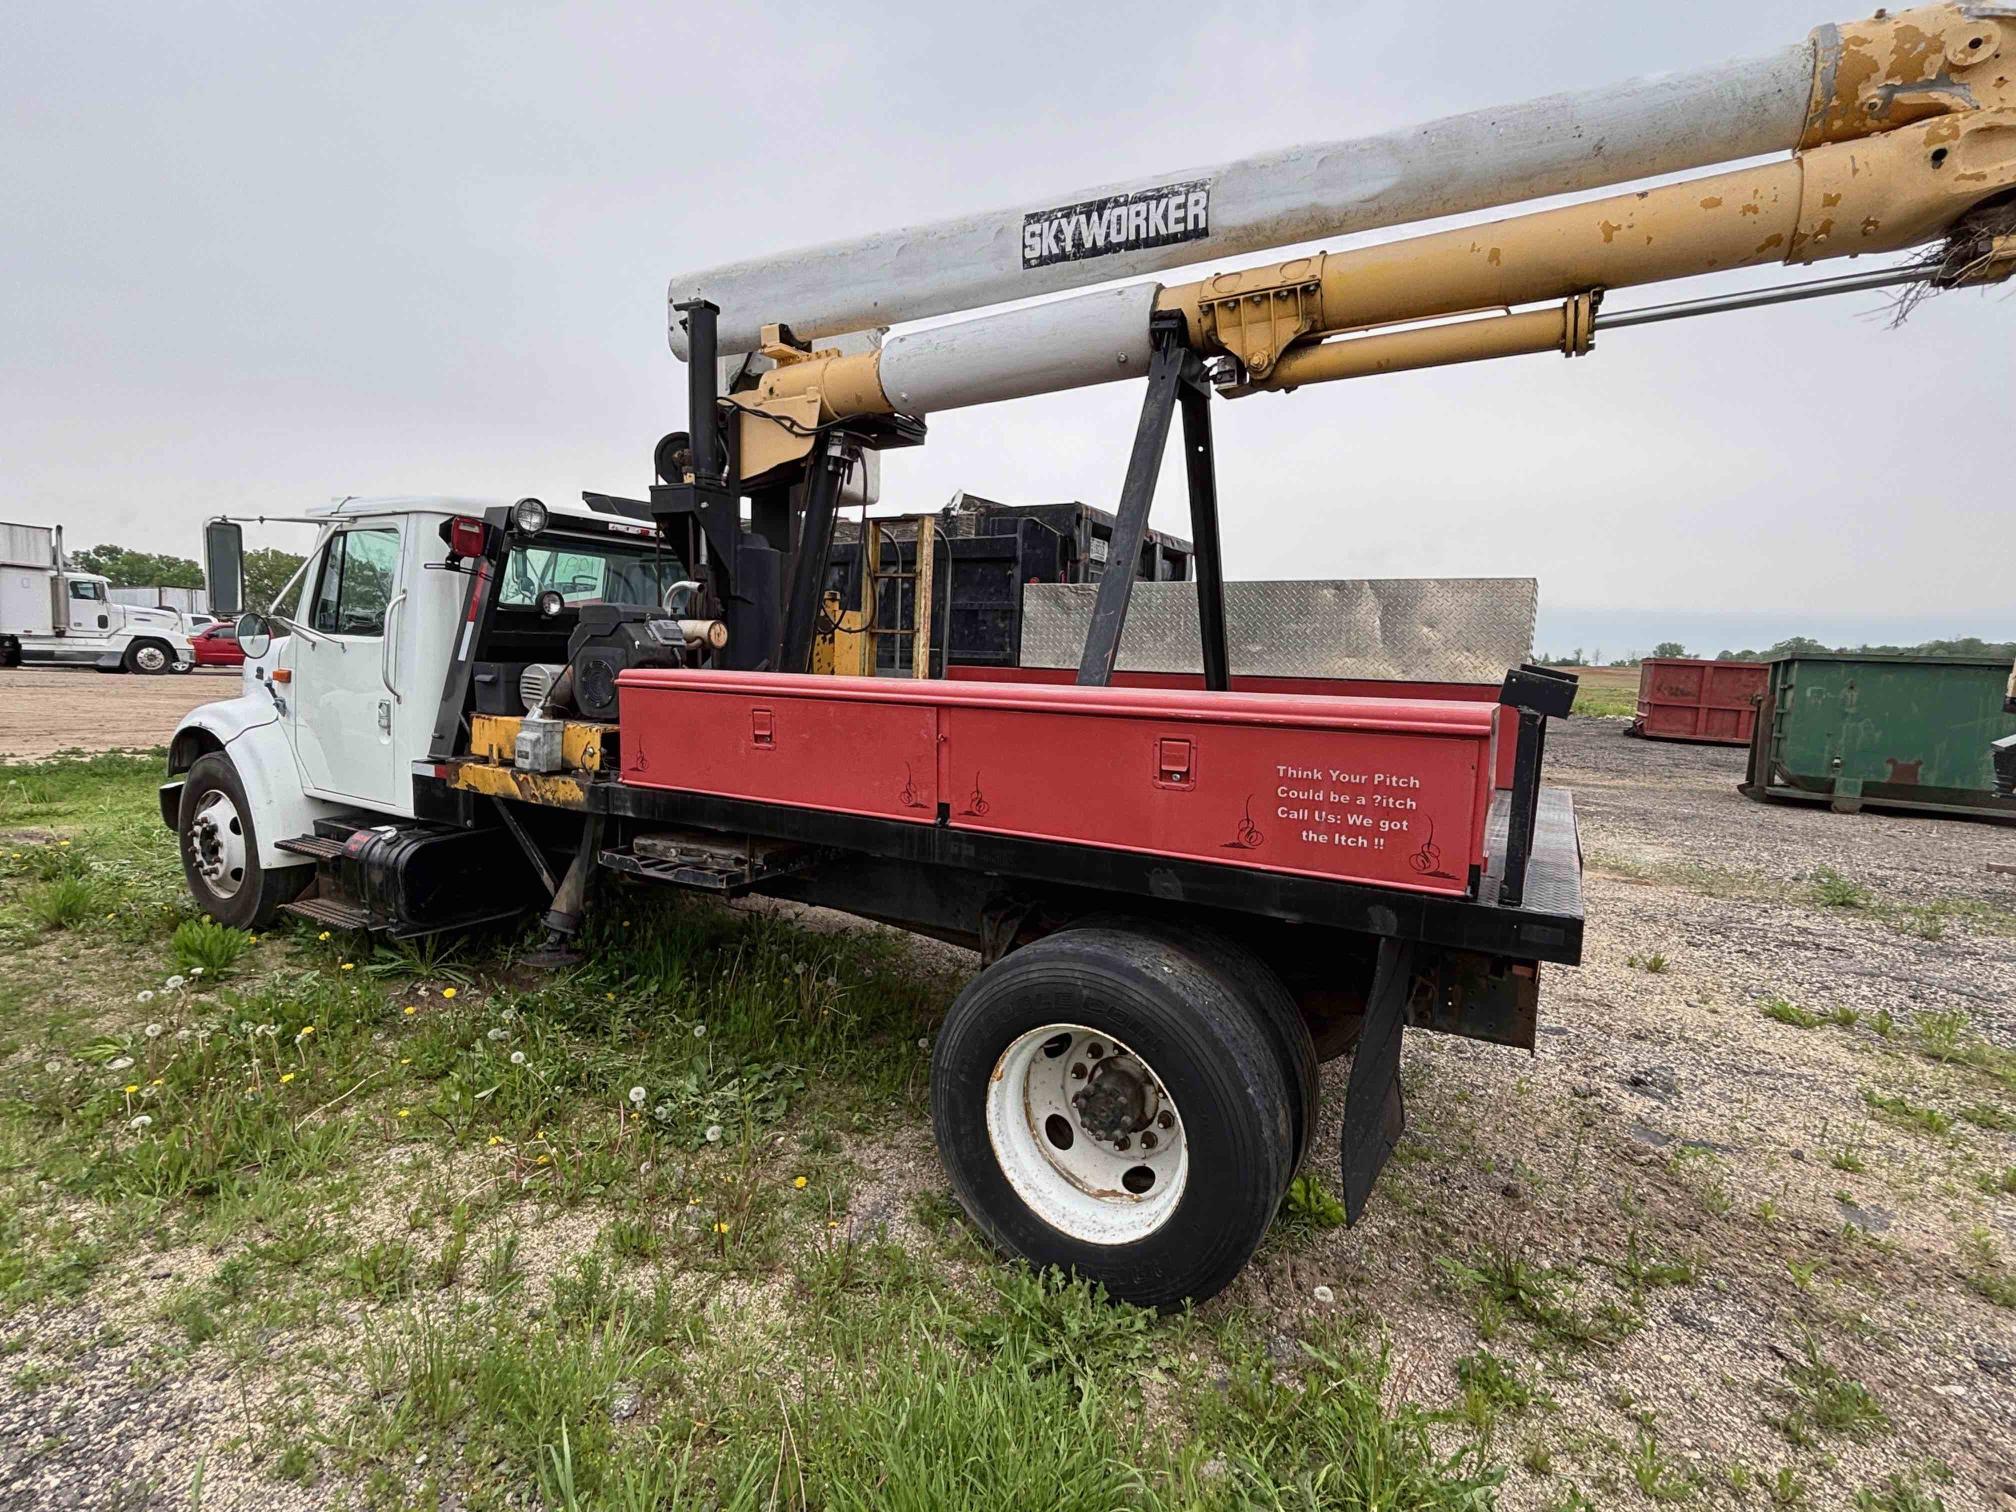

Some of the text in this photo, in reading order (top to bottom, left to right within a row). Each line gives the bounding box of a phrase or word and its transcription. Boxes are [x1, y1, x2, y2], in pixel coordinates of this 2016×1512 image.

[1023, 190, 1208, 260] SKYWORKER
[1277, 766, 1420, 788] Think Your Pitch
[1277, 787, 1417, 810] Could be a ?itch
[1277, 807, 1409, 832] Call Us: We got
[1301, 830, 1329, 844] the
[1334, 832, 1368, 848] Itch
